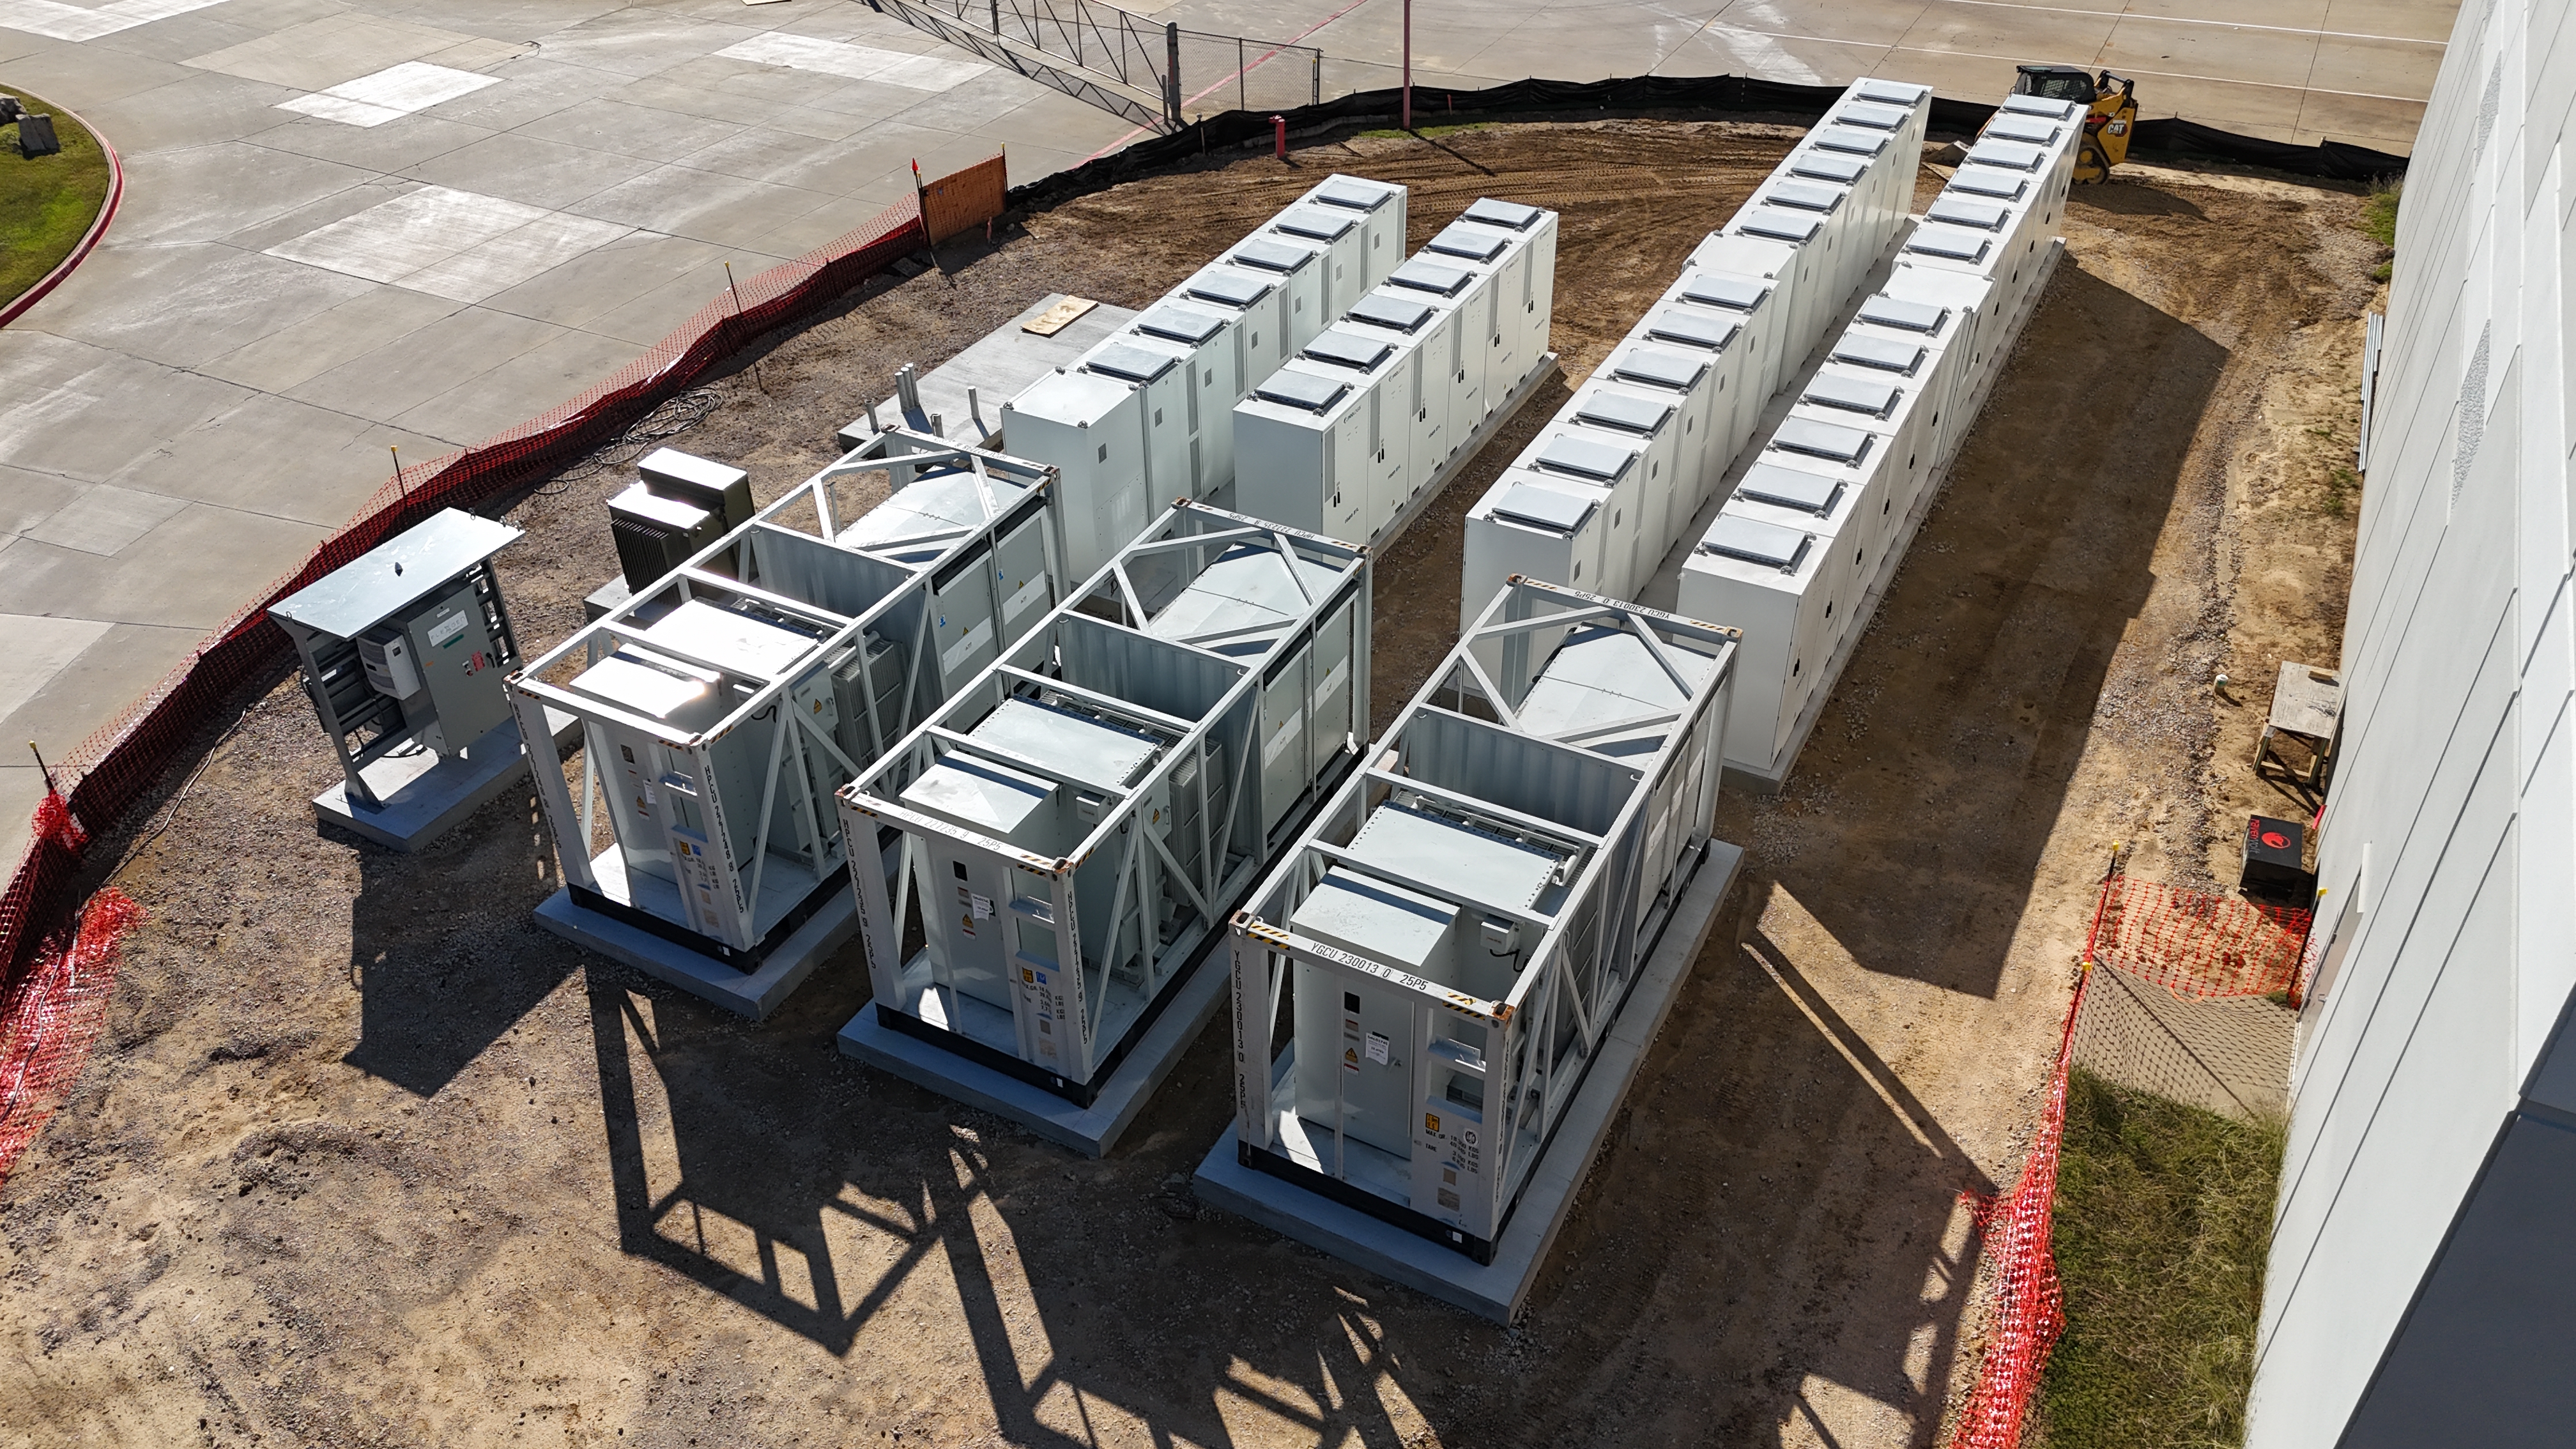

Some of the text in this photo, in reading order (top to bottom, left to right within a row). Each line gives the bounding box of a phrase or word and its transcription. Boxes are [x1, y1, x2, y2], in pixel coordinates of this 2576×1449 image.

[2108, 124, 2124, 134] CAT
[1264, 522, 1292, 533] 227235
[1294, 530, 1315, 539] HPCU
[1574, 591, 1597, 601] 25P5
[1613, 601, 1646, 613] 230013
[1647, 609, 1670, 620] YGCU
[899, 810, 924, 823] HPCU
[924, 818, 960, 835] 227235
[977, 838, 1003, 850] 25P5
[704, 765, 744, 913] HPCU 227248 8 25P5
[843, 819, 877, 969] HPCU 227235 9 25P5
[1072, 933, 1081, 990] 227235
[1310, 942, 1429, 991] YGCU 230013 0 25P5
[1238, 1052, 1245, 1062] 0
